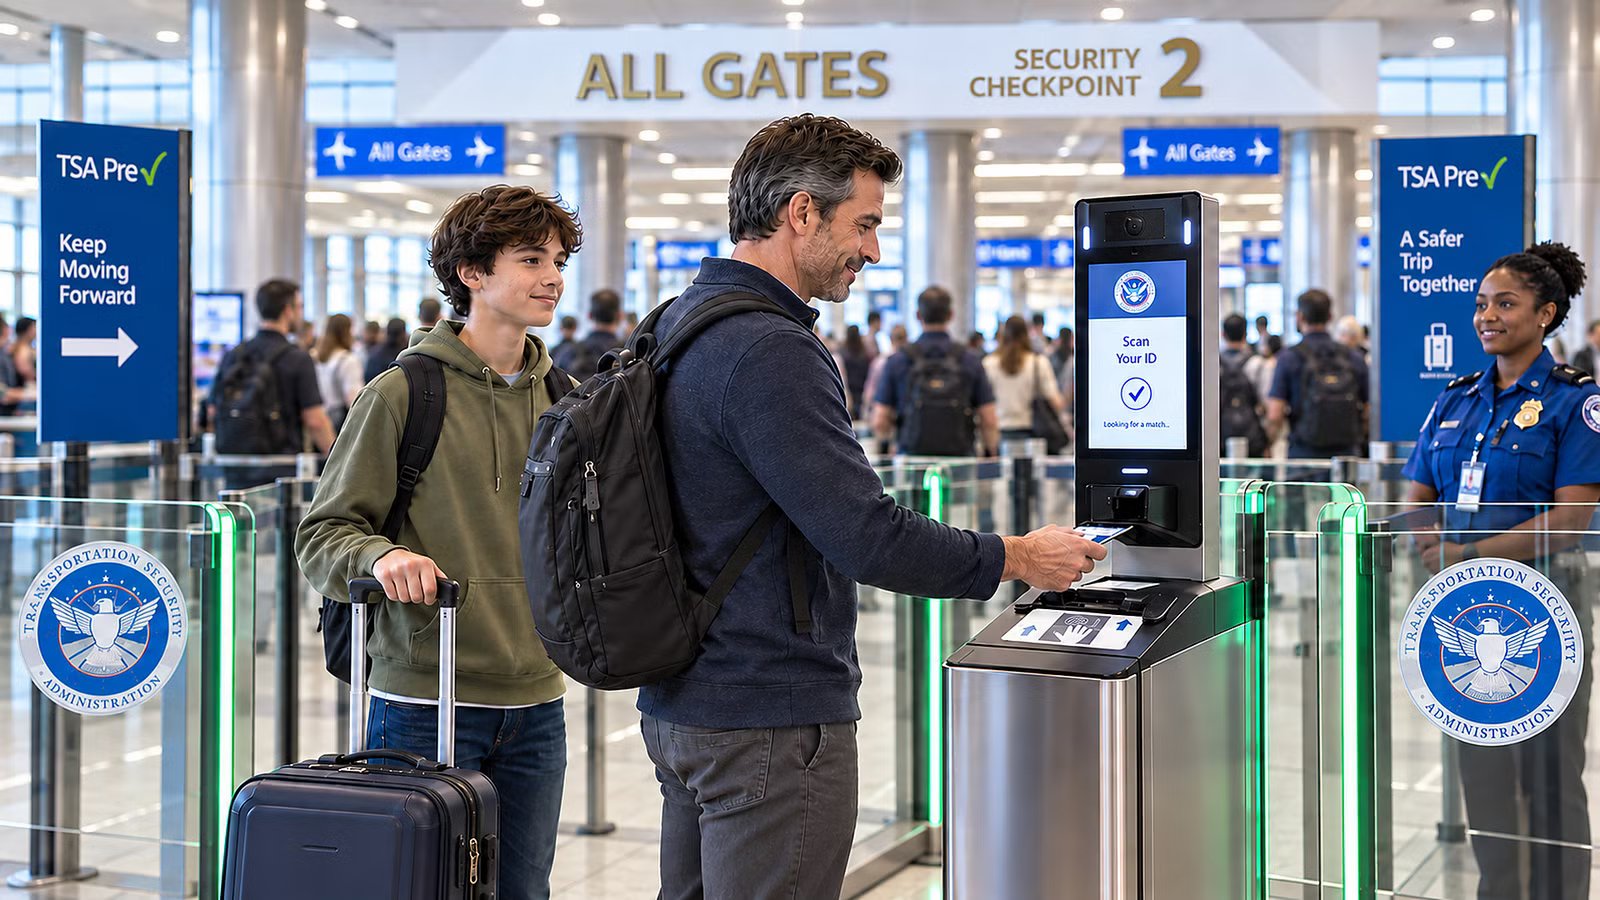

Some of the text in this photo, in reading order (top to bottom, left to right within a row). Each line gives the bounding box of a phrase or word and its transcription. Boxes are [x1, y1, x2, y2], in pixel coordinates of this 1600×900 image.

[1016, 49, 1138, 69] SECURITY
[1160, 38, 1201, 96] 2
[578, 52, 887, 98] ALL GATES
[970, 76, 1138, 96] CHECKPOINT
[369, 143, 450, 161] All Gates
[1166, 144, 1235, 161] All Gates
[57, 154, 138, 182] TSA Pre
[1398, 166, 1478, 187] TSA Pre
[60, 234, 106, 258] Keep
[1400, 229, 1463, 247] A Safer
[60, 259, 128, 284] Moving
[1400, 252, 1432, 273] Trip
[60, 285, 135, 304] Forward
[1400, 274, 1477, 297] Together
[1123, 336, 1149, 347] Scan
[1116, 353, 1157, 363] Your ID
[1103, 421, 1129, 429] Looking
[43, 674, 161, 710] ADMINISTRATION
[1425, 703, 1555, 739] ADMINISTRATION
